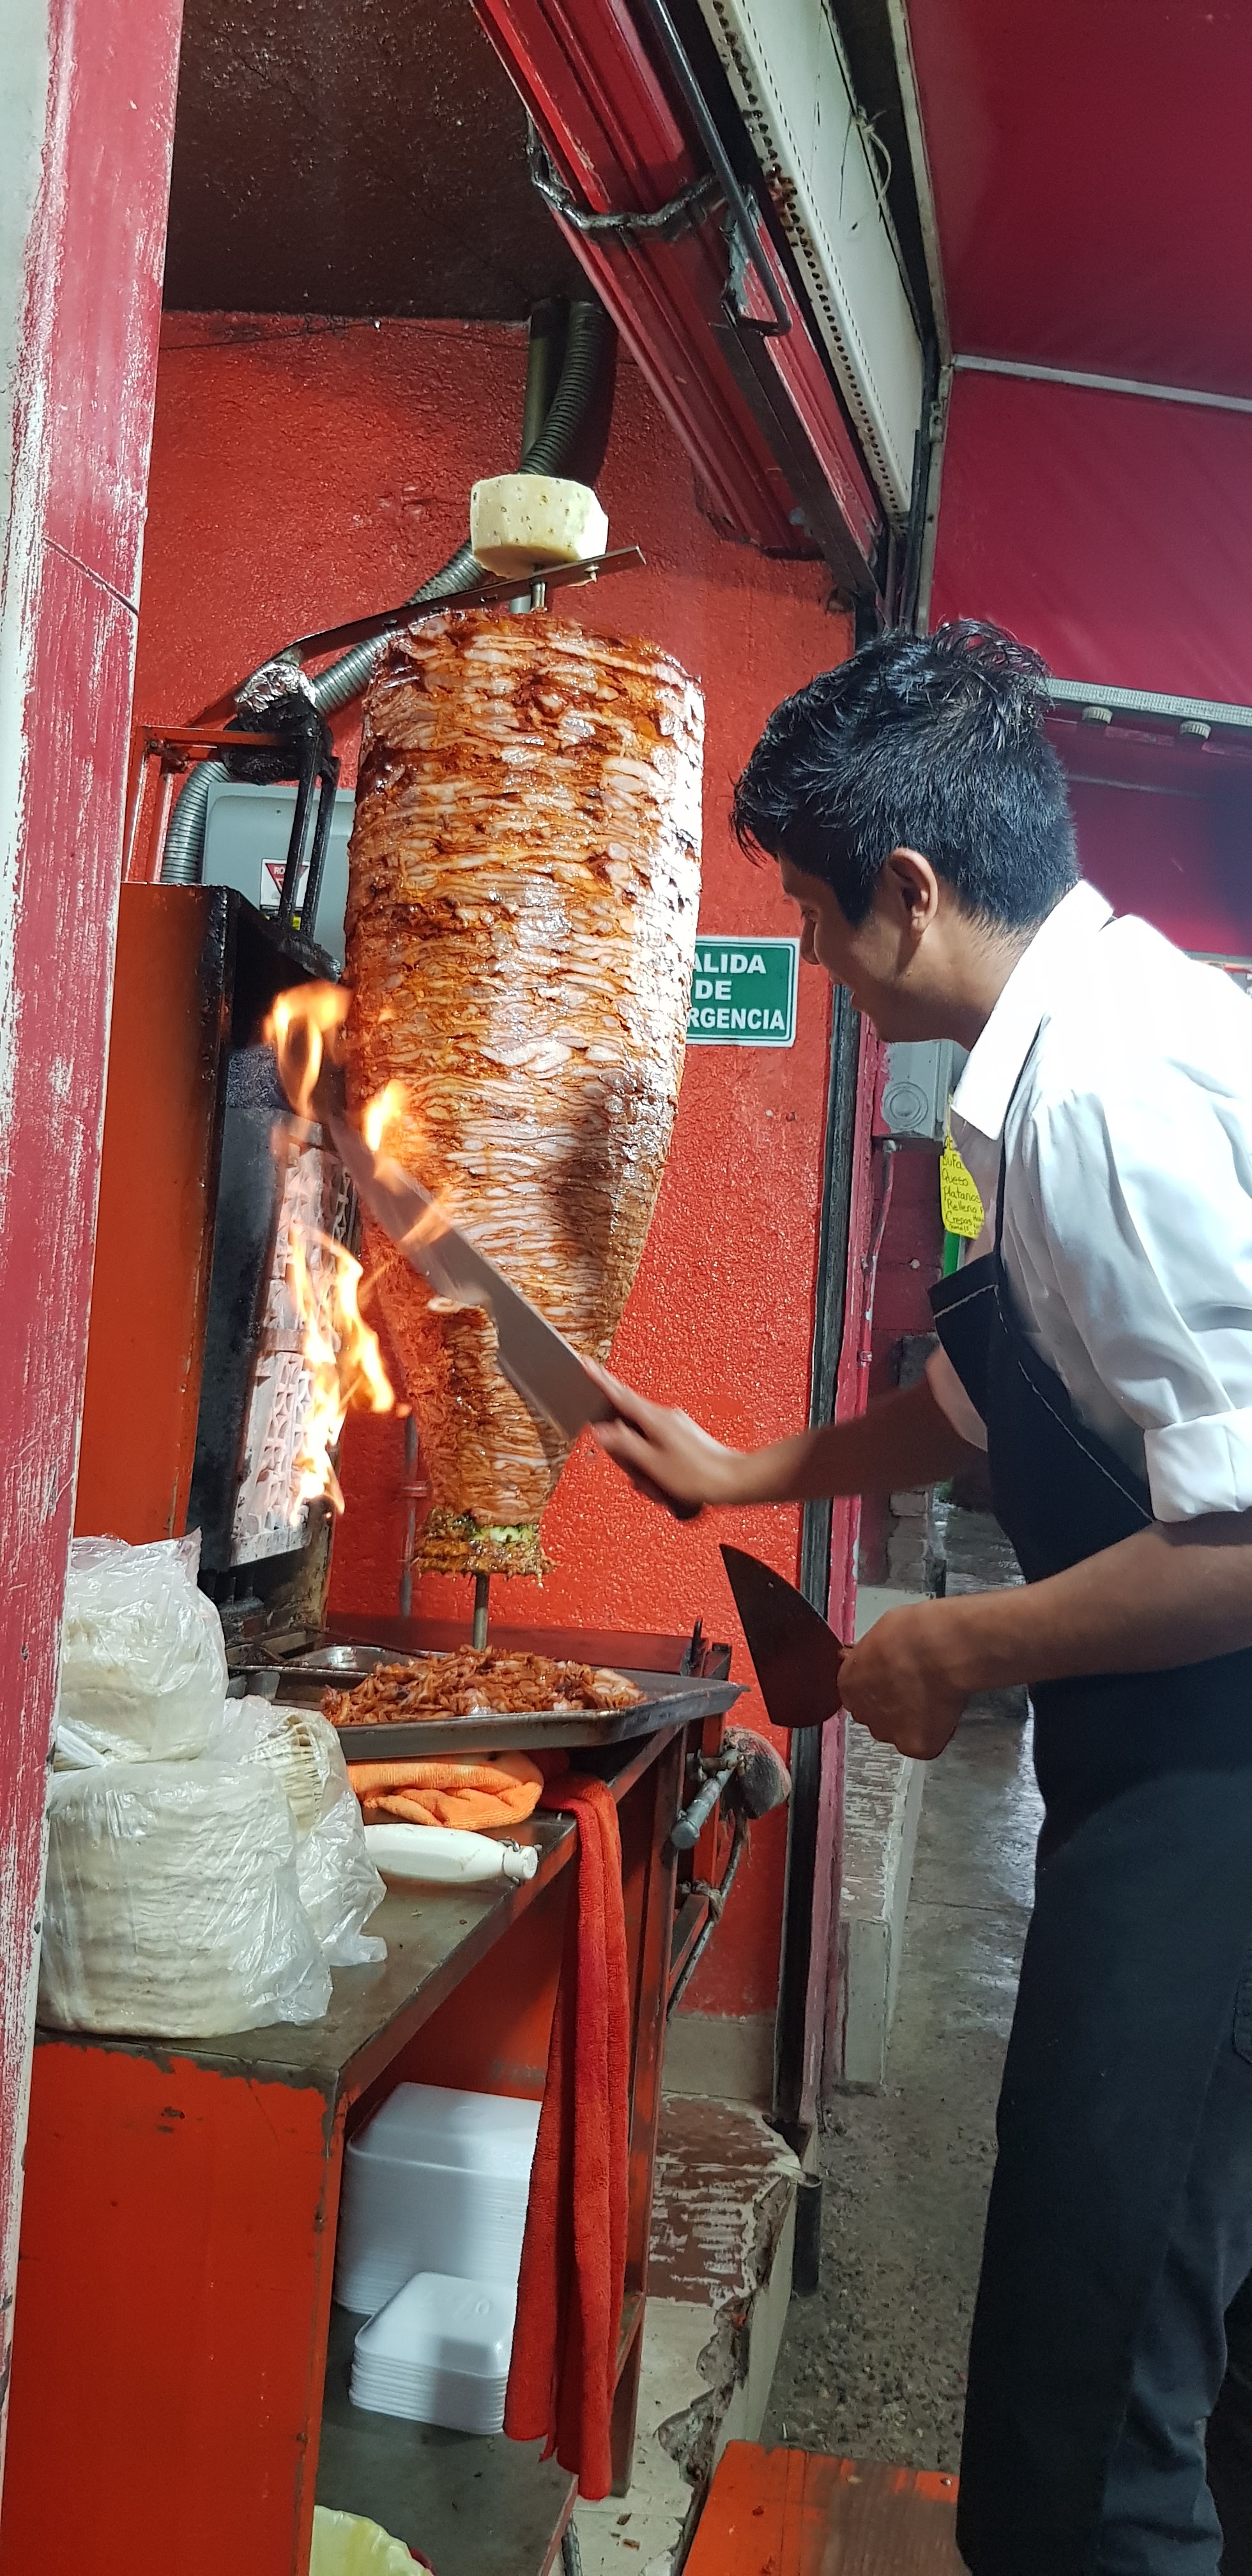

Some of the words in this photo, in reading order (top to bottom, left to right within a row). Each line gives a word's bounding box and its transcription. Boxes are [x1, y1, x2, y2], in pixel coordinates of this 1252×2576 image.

[274, 866, 286, 875] RO
[694, 953, 767, 974] ALIDA
[694, 979, 732, 1000] DE
[687, 1007, 786, 1031] RGENCIA
